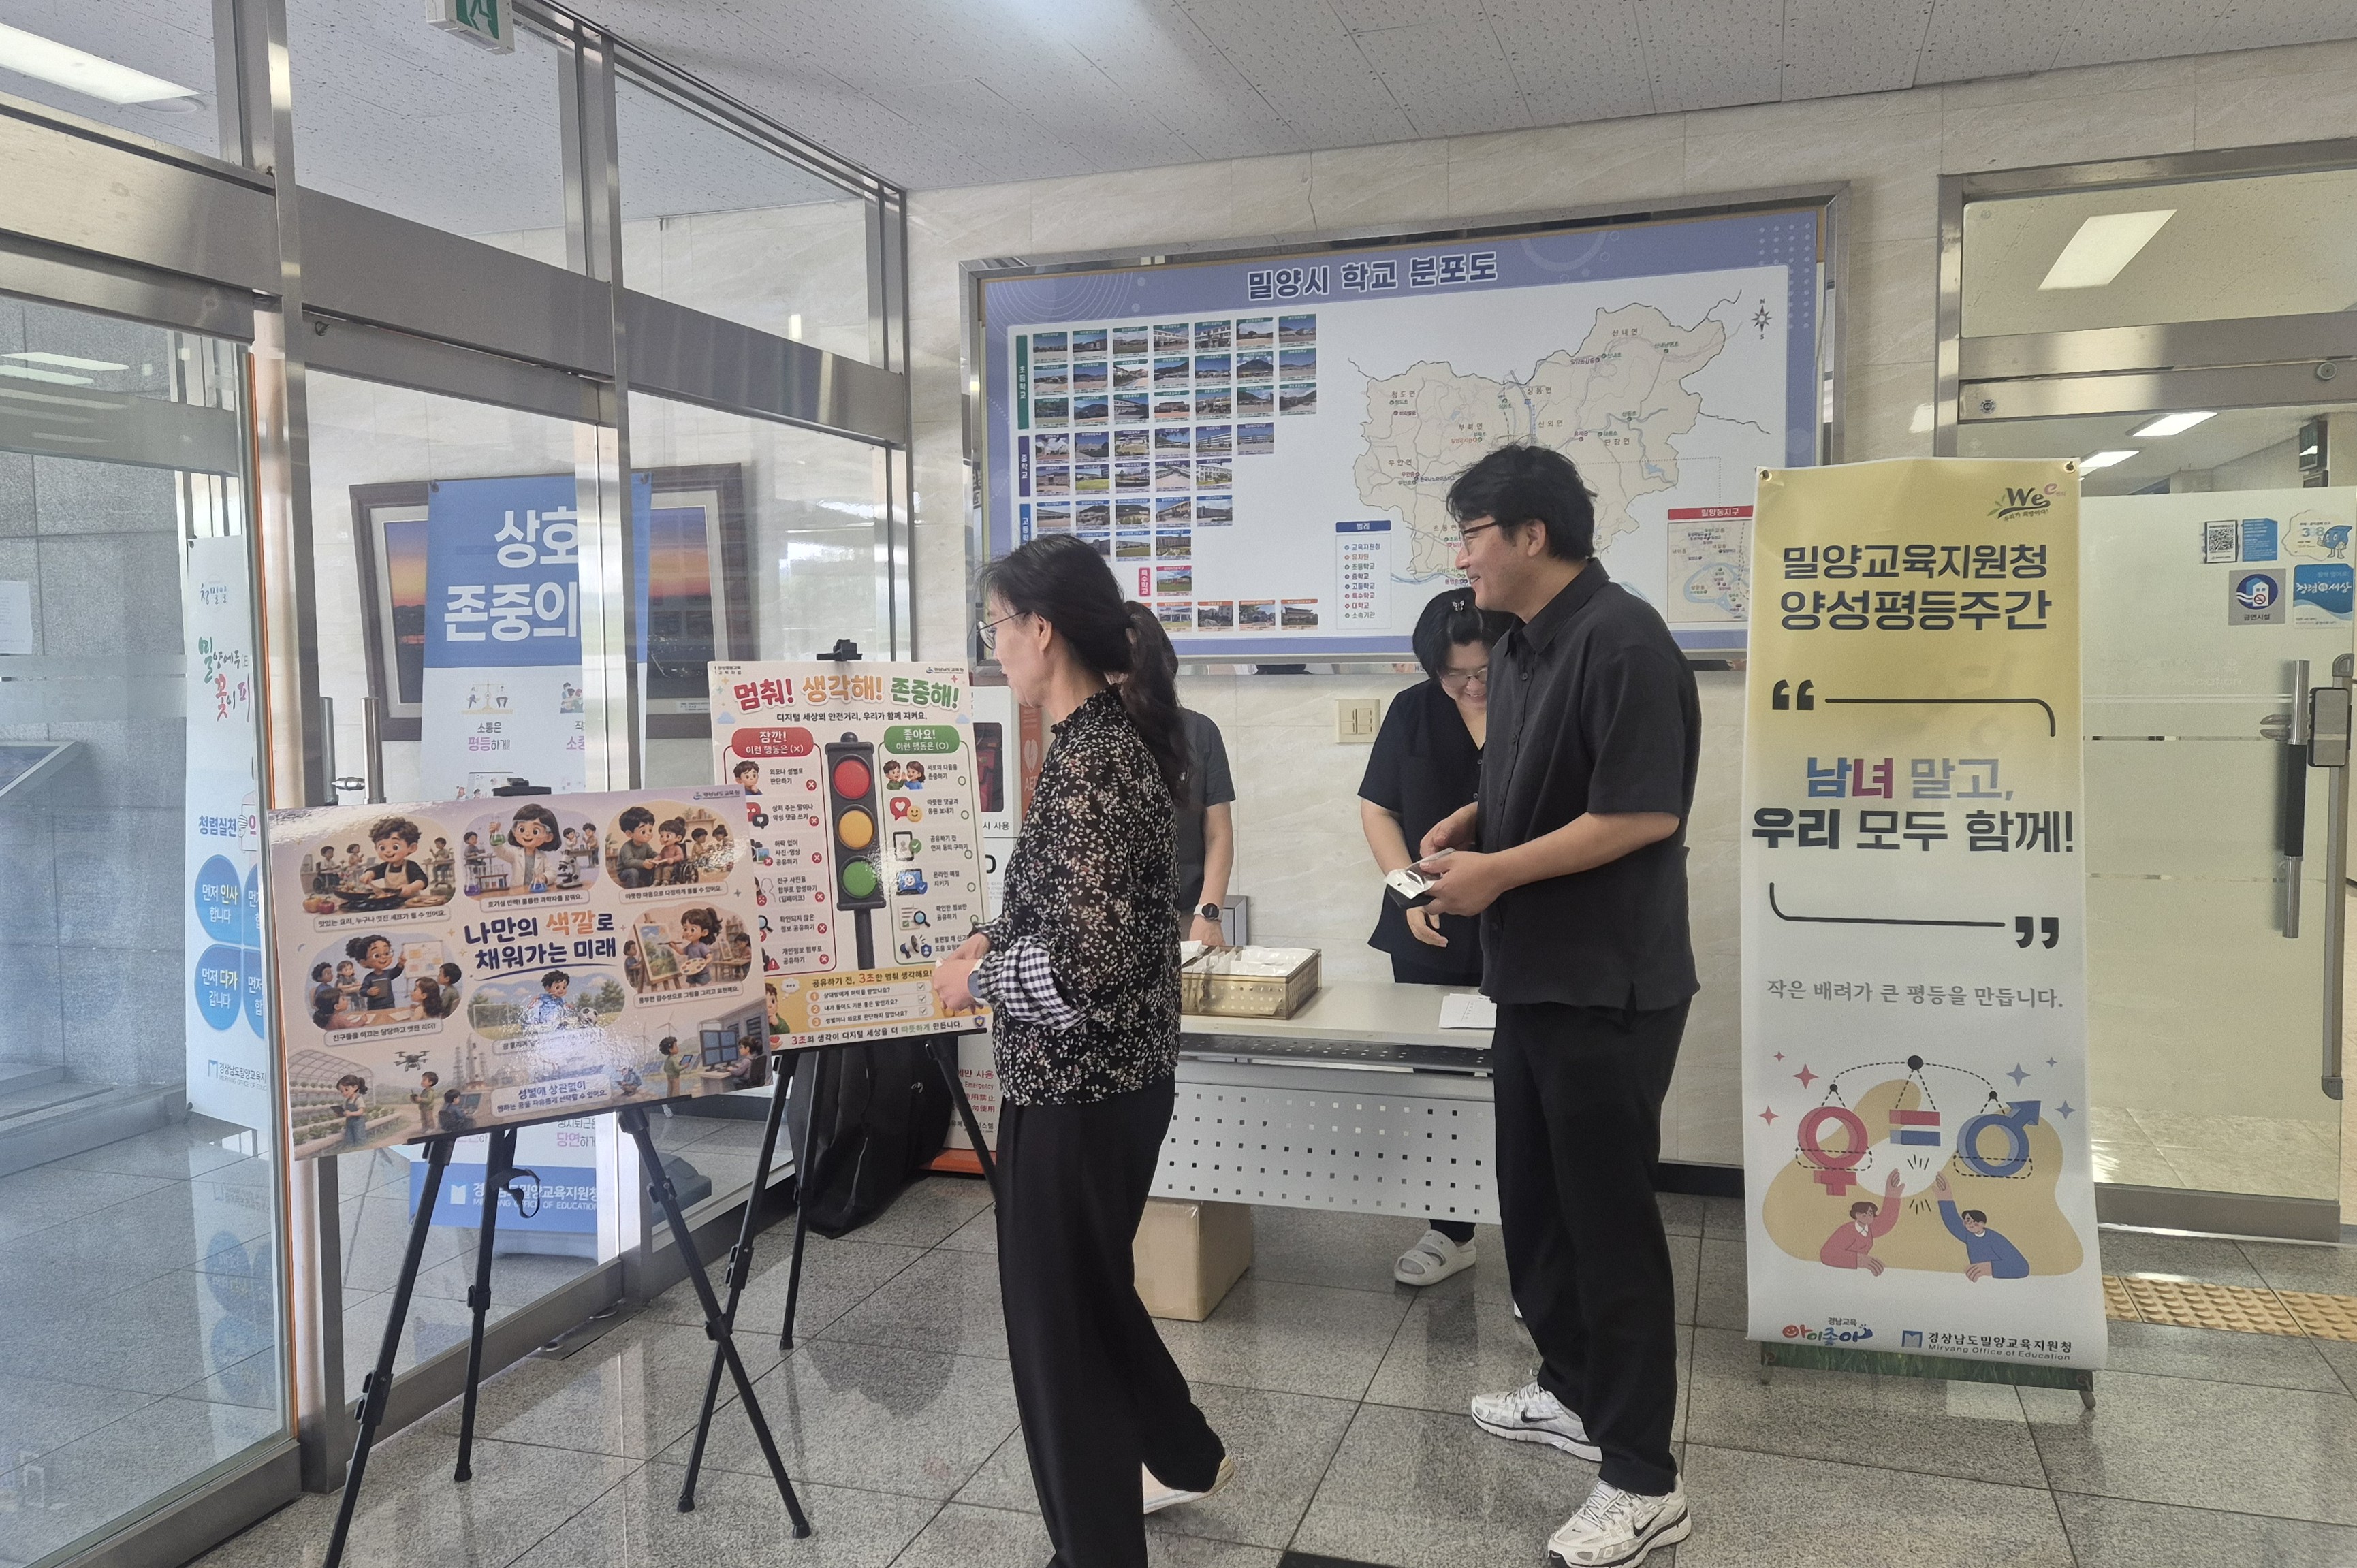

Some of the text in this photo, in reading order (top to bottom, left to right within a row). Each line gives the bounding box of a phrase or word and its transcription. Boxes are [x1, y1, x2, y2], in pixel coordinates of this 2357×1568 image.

[1250, 252, 1496, 300] 밀양시 학교 분포도
[494, 505, 579, 569] 상호
[1783, 544, 2048, 579] 밀양교육지원청
[444, 581, 578, 642] 존중의
[1780, 590, 2052, 630] 양성평등주간
[734, 675, 959, 711] 멈춰! 생각해! 존중해!
[477, 722, 502, 733] 소통은
[776, 713, 800, 722] 디지털
[803, 712, 826, 722] 세상의
[828, 712, 861, 722] 안전거리,
[863, 712, 885, 721] 우리가
[887, 711, 901, 720] 함께
[759, 731, 787, 743] 잠깐!
[896, 741, 911, 751] 이런
[913, 741, 934, 751] 행동은
[903, 729, 936, 741] 좋아요!
[746, 746, 761, 755] 이런
[763, 745, 788, 754] 행동은
[1807, 756, 2014, 801] 남녀 말고,
[199, 815, 236, 837] 청렴실천
[993, 821, 1010, 831] 사용
[1752, 807, 2074, 852] 우리 모두 함께!
[202, 884, 238, 905] 먼저 인사
[209, 906, 231, 924] 합니다
[355, 916, 375, 924] 누구나
[464, 910, 614, 944] 나만의 색깔로
[475, 936, 616, 970] 채워가는 미래
[202, 968, 238, 991] 먼저 다가
[812, 976, 842, 988] 공유하기
[845, 975, 855, 985] 전,
[859, 973, 883, 985] 3초만
[901, 970, 932, 980] 생각해요!
[1767, 979, 2063, 1009] 작은 배려가 큰 평등을 만듭니다.
[791, 1035, 814, 1046] 3초의
[817, 1033, 840, 1044] 생각이
[842, 1030, 864, 1040] 디지털
[867, 1028, 888, 1038] 세상을
[891, 1027, 898, 1036] 더
[933, 1021, 963, 1031] 만듭니다.
[976, 1070, 994, 1079] 사용
[1828, 1317, 1857, 1327] 경남교육
[1928, 1331, 2072, 1354] 경상남도밀양교육지원청
[1929, 1344, 1968, 1355] Miryang
[1972, 1347, 2002, 1356] Office
[2018, 1351, 2070, 1360] Education
